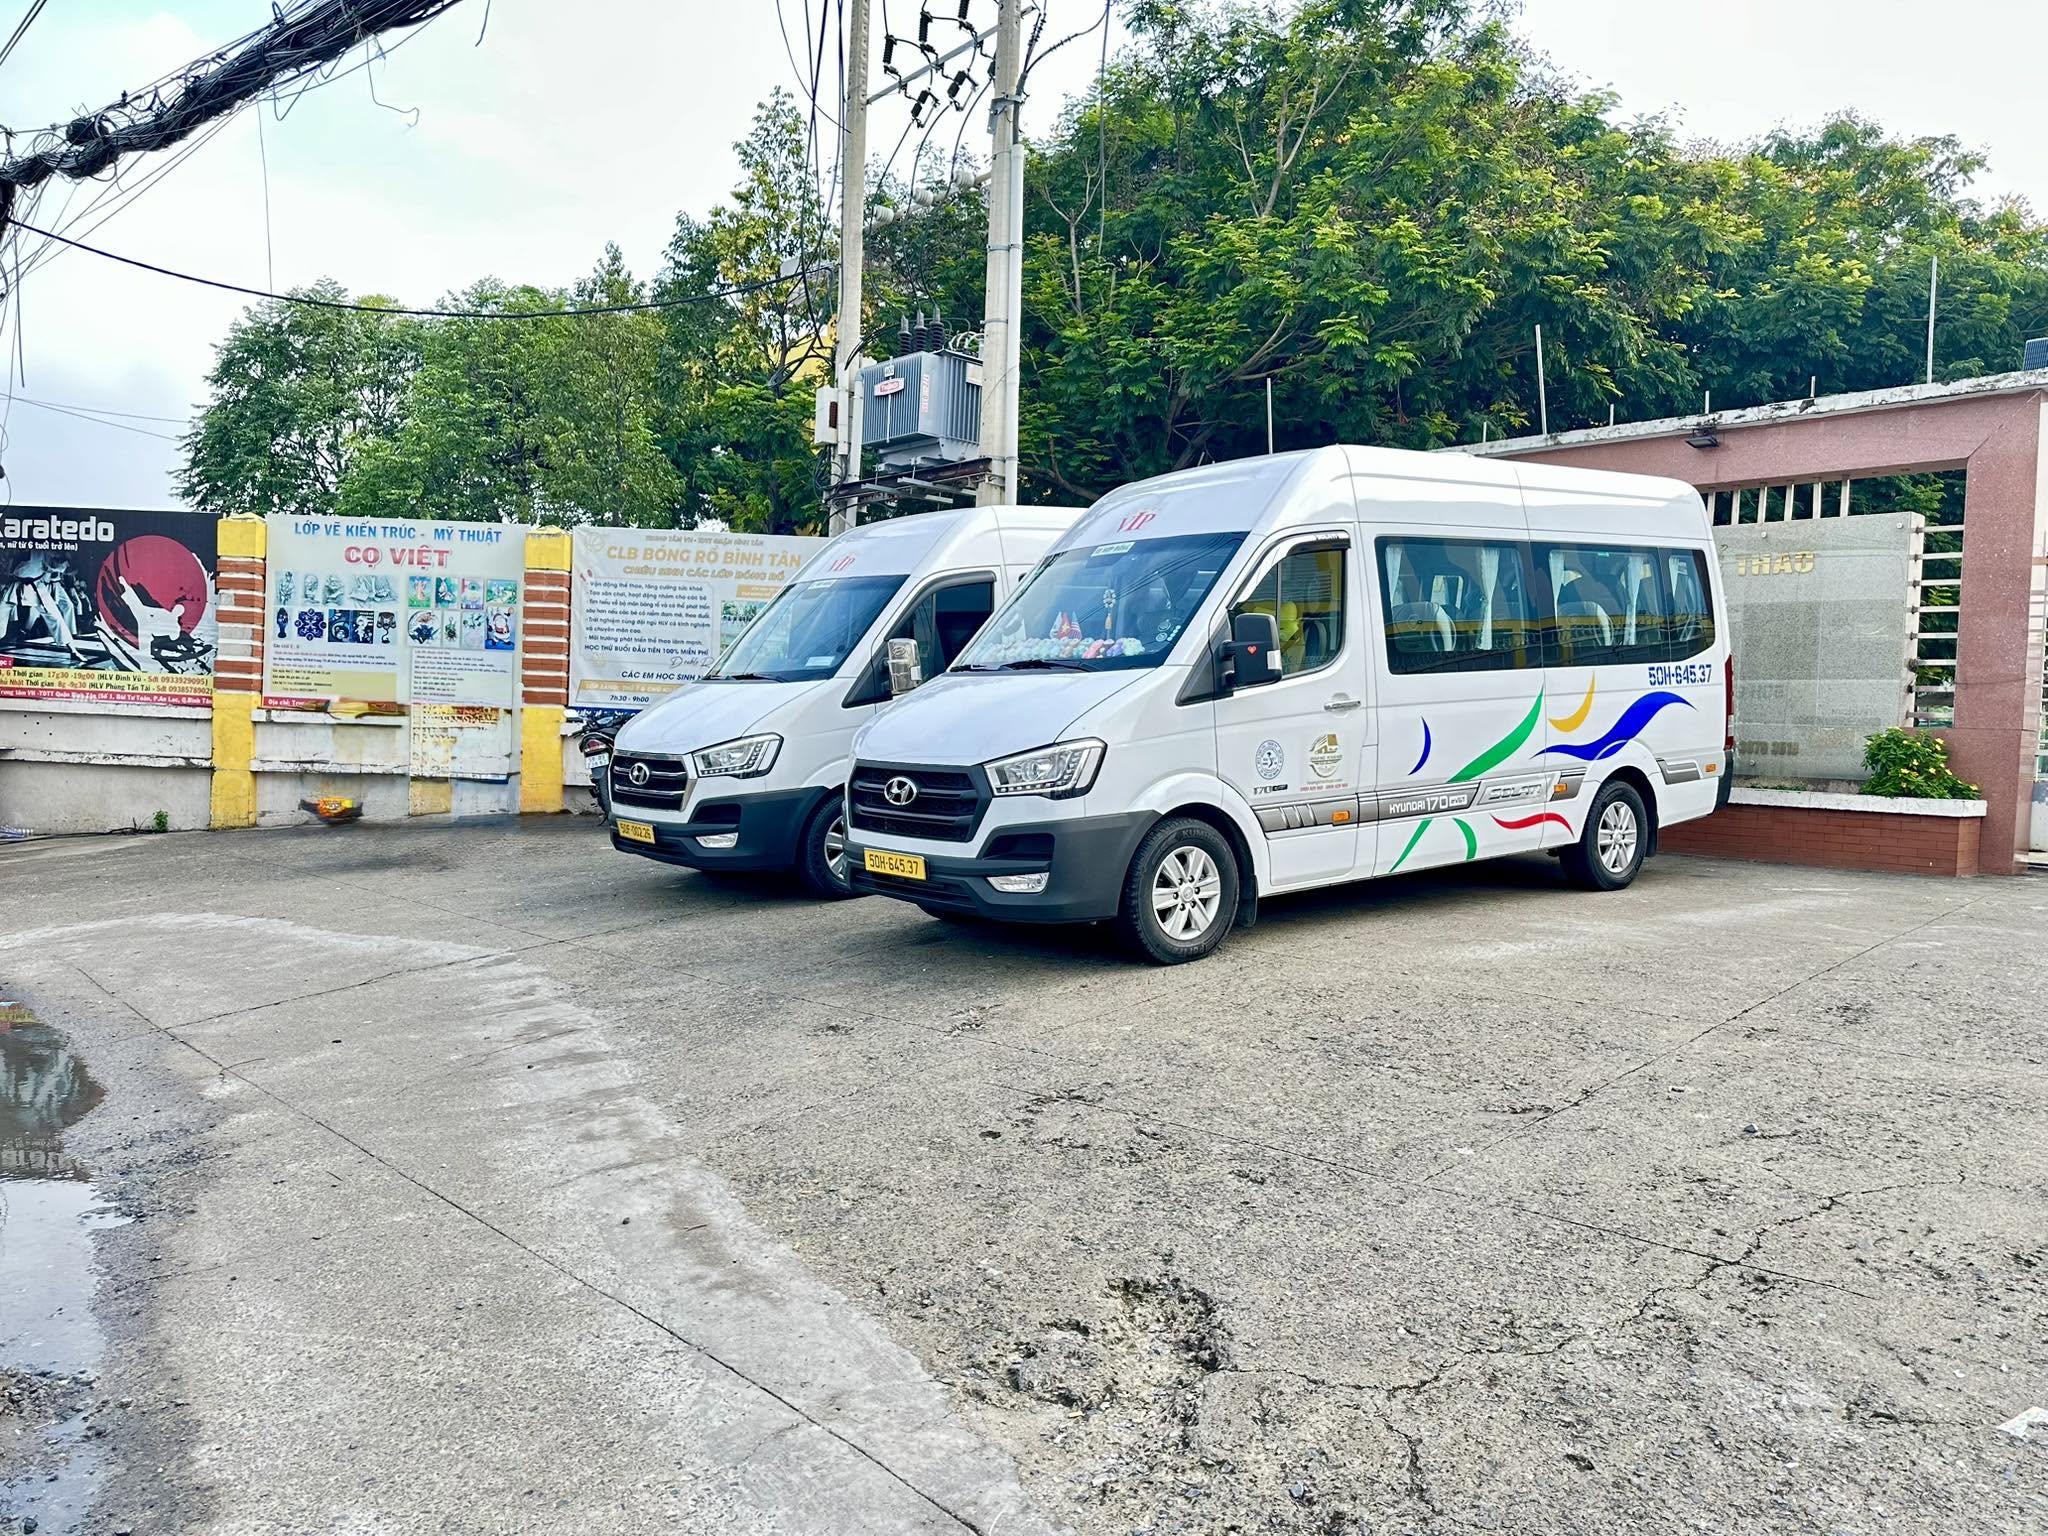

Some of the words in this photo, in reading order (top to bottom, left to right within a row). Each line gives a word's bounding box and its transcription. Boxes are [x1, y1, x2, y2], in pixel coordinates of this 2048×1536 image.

[0, 513, 115, 542] aratedo
[294, 520, 320, 535] LỚP
[325, 523, 341, 536] VẼ
[346, 520, 377, 538] KIẾN
[382, 522, 416, 539] TRÚC
[434, 525, 454, 540] MỸ
[458, 528, 502, 545] THUẬT
[1116, 512, 1156, 533] VIP
[28, 541, 33, 549] 6
[344, 545, 382, 568] CỌ
[390, 545, 452, 570] VIỆT
[607, 546, 638, 560] CLB
[642, 545, 690, 562] BÓNG
[695, 545, 719, 564] RỔ
[723, 547, 764, 566] BÌNH
[769, 550, 801, 568] TÂN
[829, 556, 855, 571] VIP
[585, 644, 599, 652] HỌC
[663, 647, 679, 655] 100%
[47, 671, 69, 680] 17g30
[621, 670, 641, 680] CÁC
[642, 672, 654, 680] EM
[656, 672, 675, 681] HỌC
[676, 673, 696, 681] SINH
[1648, 664, 1712, 686] 50H-645.37
[610, 694, 628, 702] 7h30
[632, 695, 650, 703] 9h00
[1389, 801, 1426, 814] HYUNDAI
[1426, 795, 1449, 812] 170
[868, 853, 919, 875] 50H-645.37
